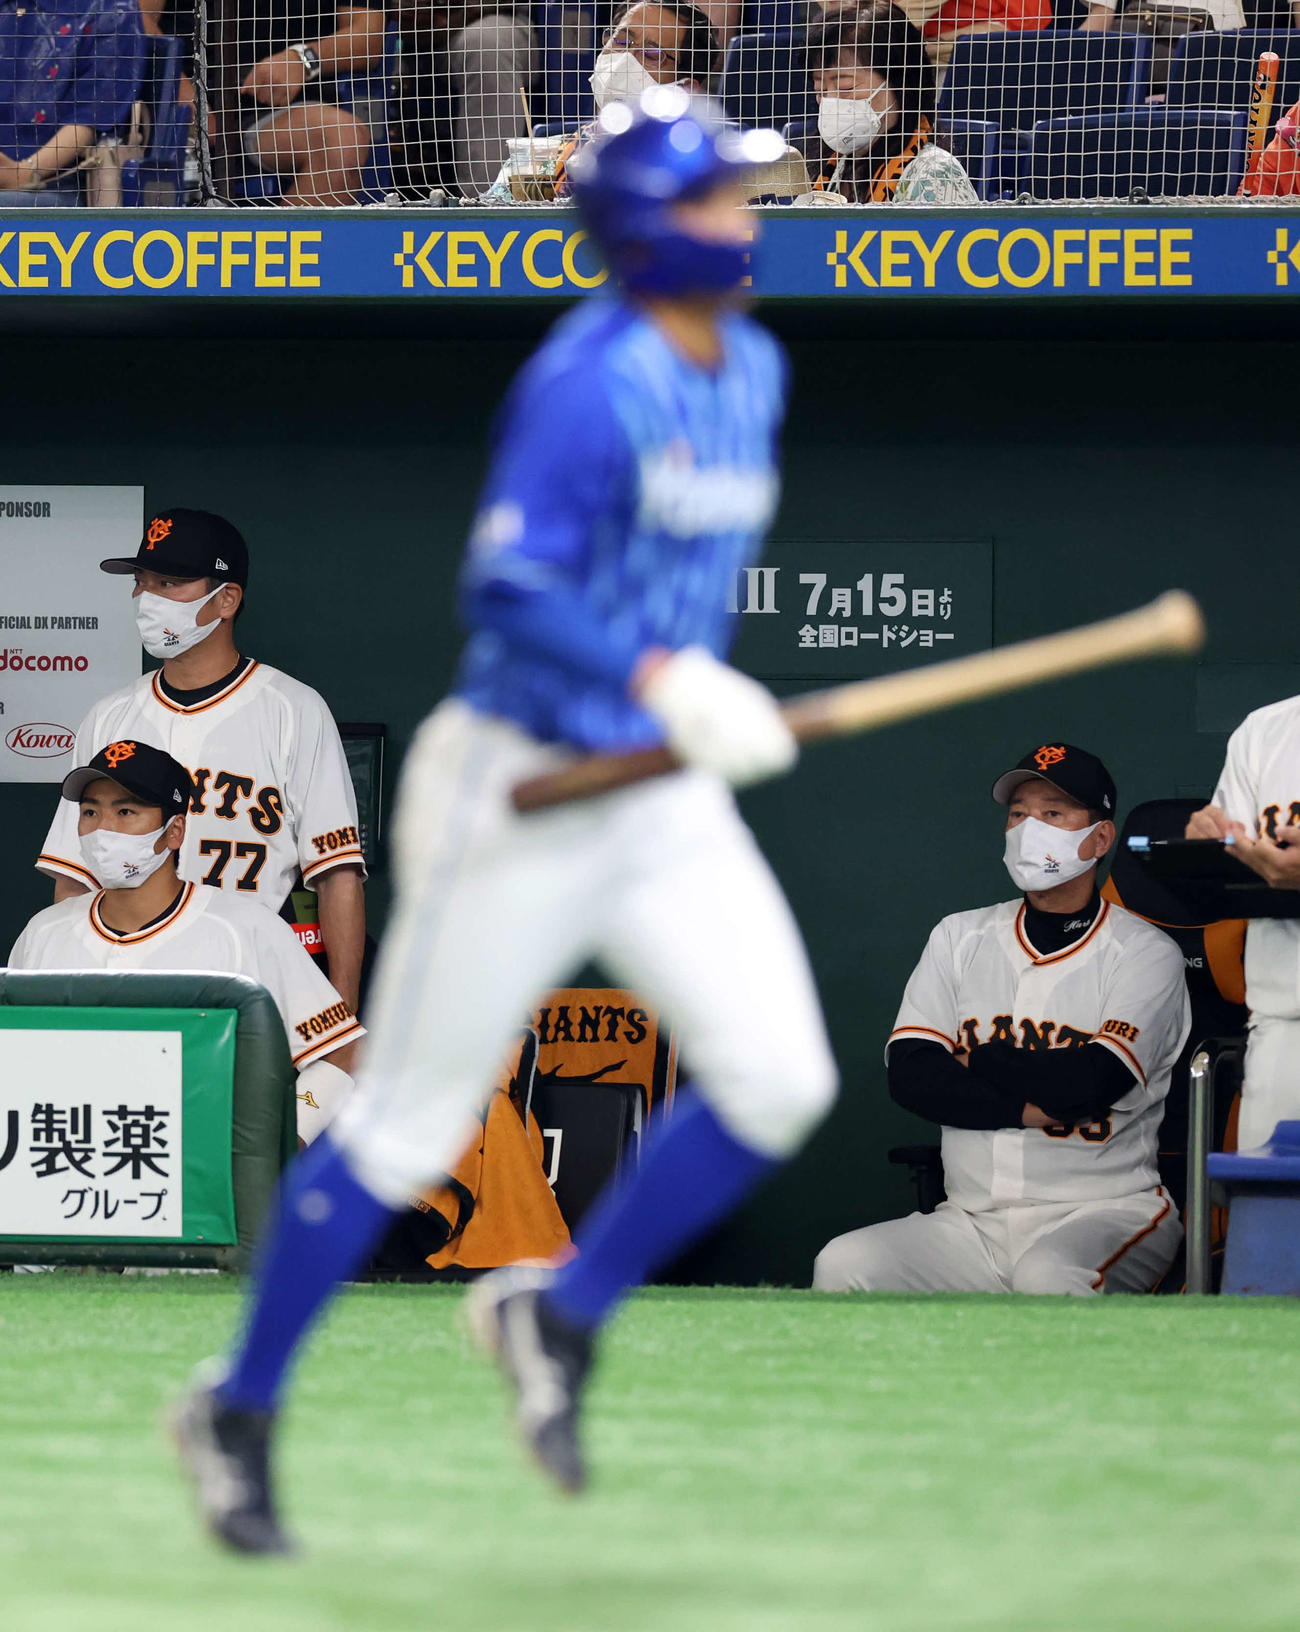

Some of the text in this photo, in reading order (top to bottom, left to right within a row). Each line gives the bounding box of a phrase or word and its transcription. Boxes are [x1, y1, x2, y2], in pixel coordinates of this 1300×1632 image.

[34, 616, 49, 629] DX
[50, 616, 98, 629] PARTNER
[798, 624, 955, 648] 全国ロードショー
[11, 728, 75, 749] Kowa
[198, 838, 268, 892] 77
[537, 1005, 649, 1045] IANTS
[61, 1186, 168, 1221] グループ
